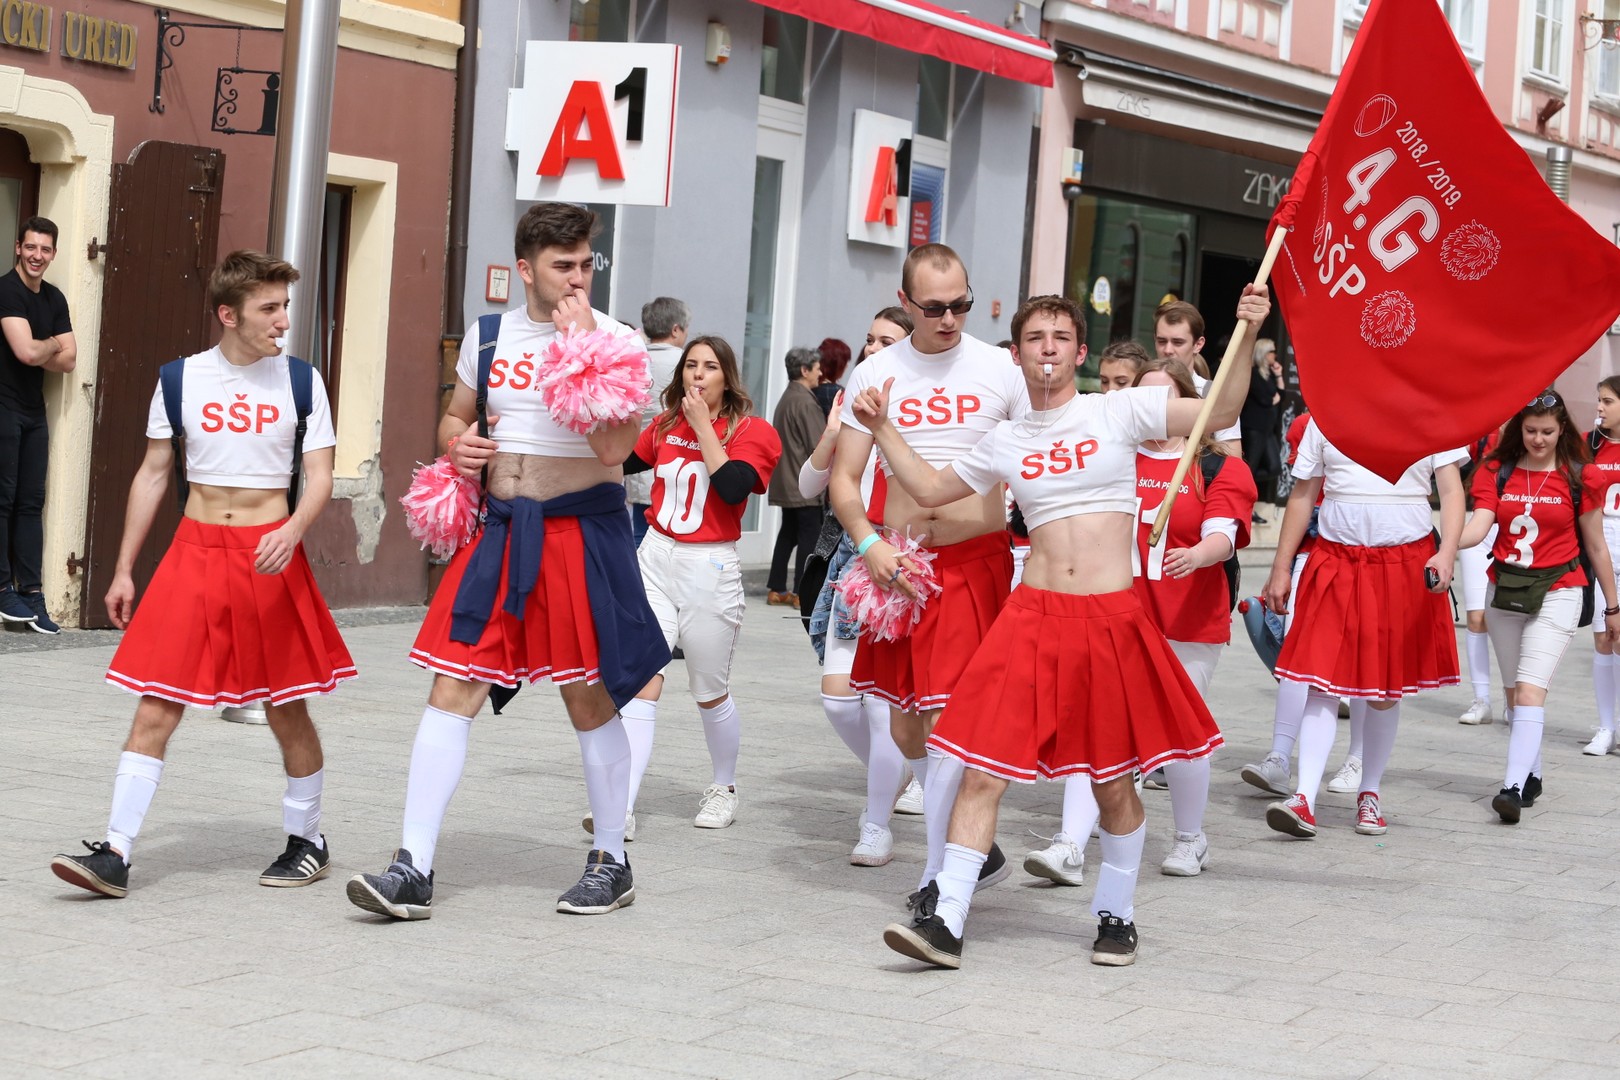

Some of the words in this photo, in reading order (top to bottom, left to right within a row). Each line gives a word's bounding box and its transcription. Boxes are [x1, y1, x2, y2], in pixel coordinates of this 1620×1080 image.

[0, 0, 50, 51] CKI
[65, 11, 137, 67] URED
[536, 67, 648, 181] A1
[865, 138, 912, 226] A1
[1313, 222, 1366, 298] SŠP
[487, 352, 540, 391] SŠ
[201, 393, 279, 433] SŠP
[897, 387, 981, 427] SŠP
[1020, 440, 1099, 480] SŠP
[656, 456, 711, 535] 10
[1138, 477, 1160, 489] ŠKOLA
[1161, 481, 1189, 494] PROG
[1539, 496, 1562, 505] PRELOG
[1505, 514, 1539, 569] 3
